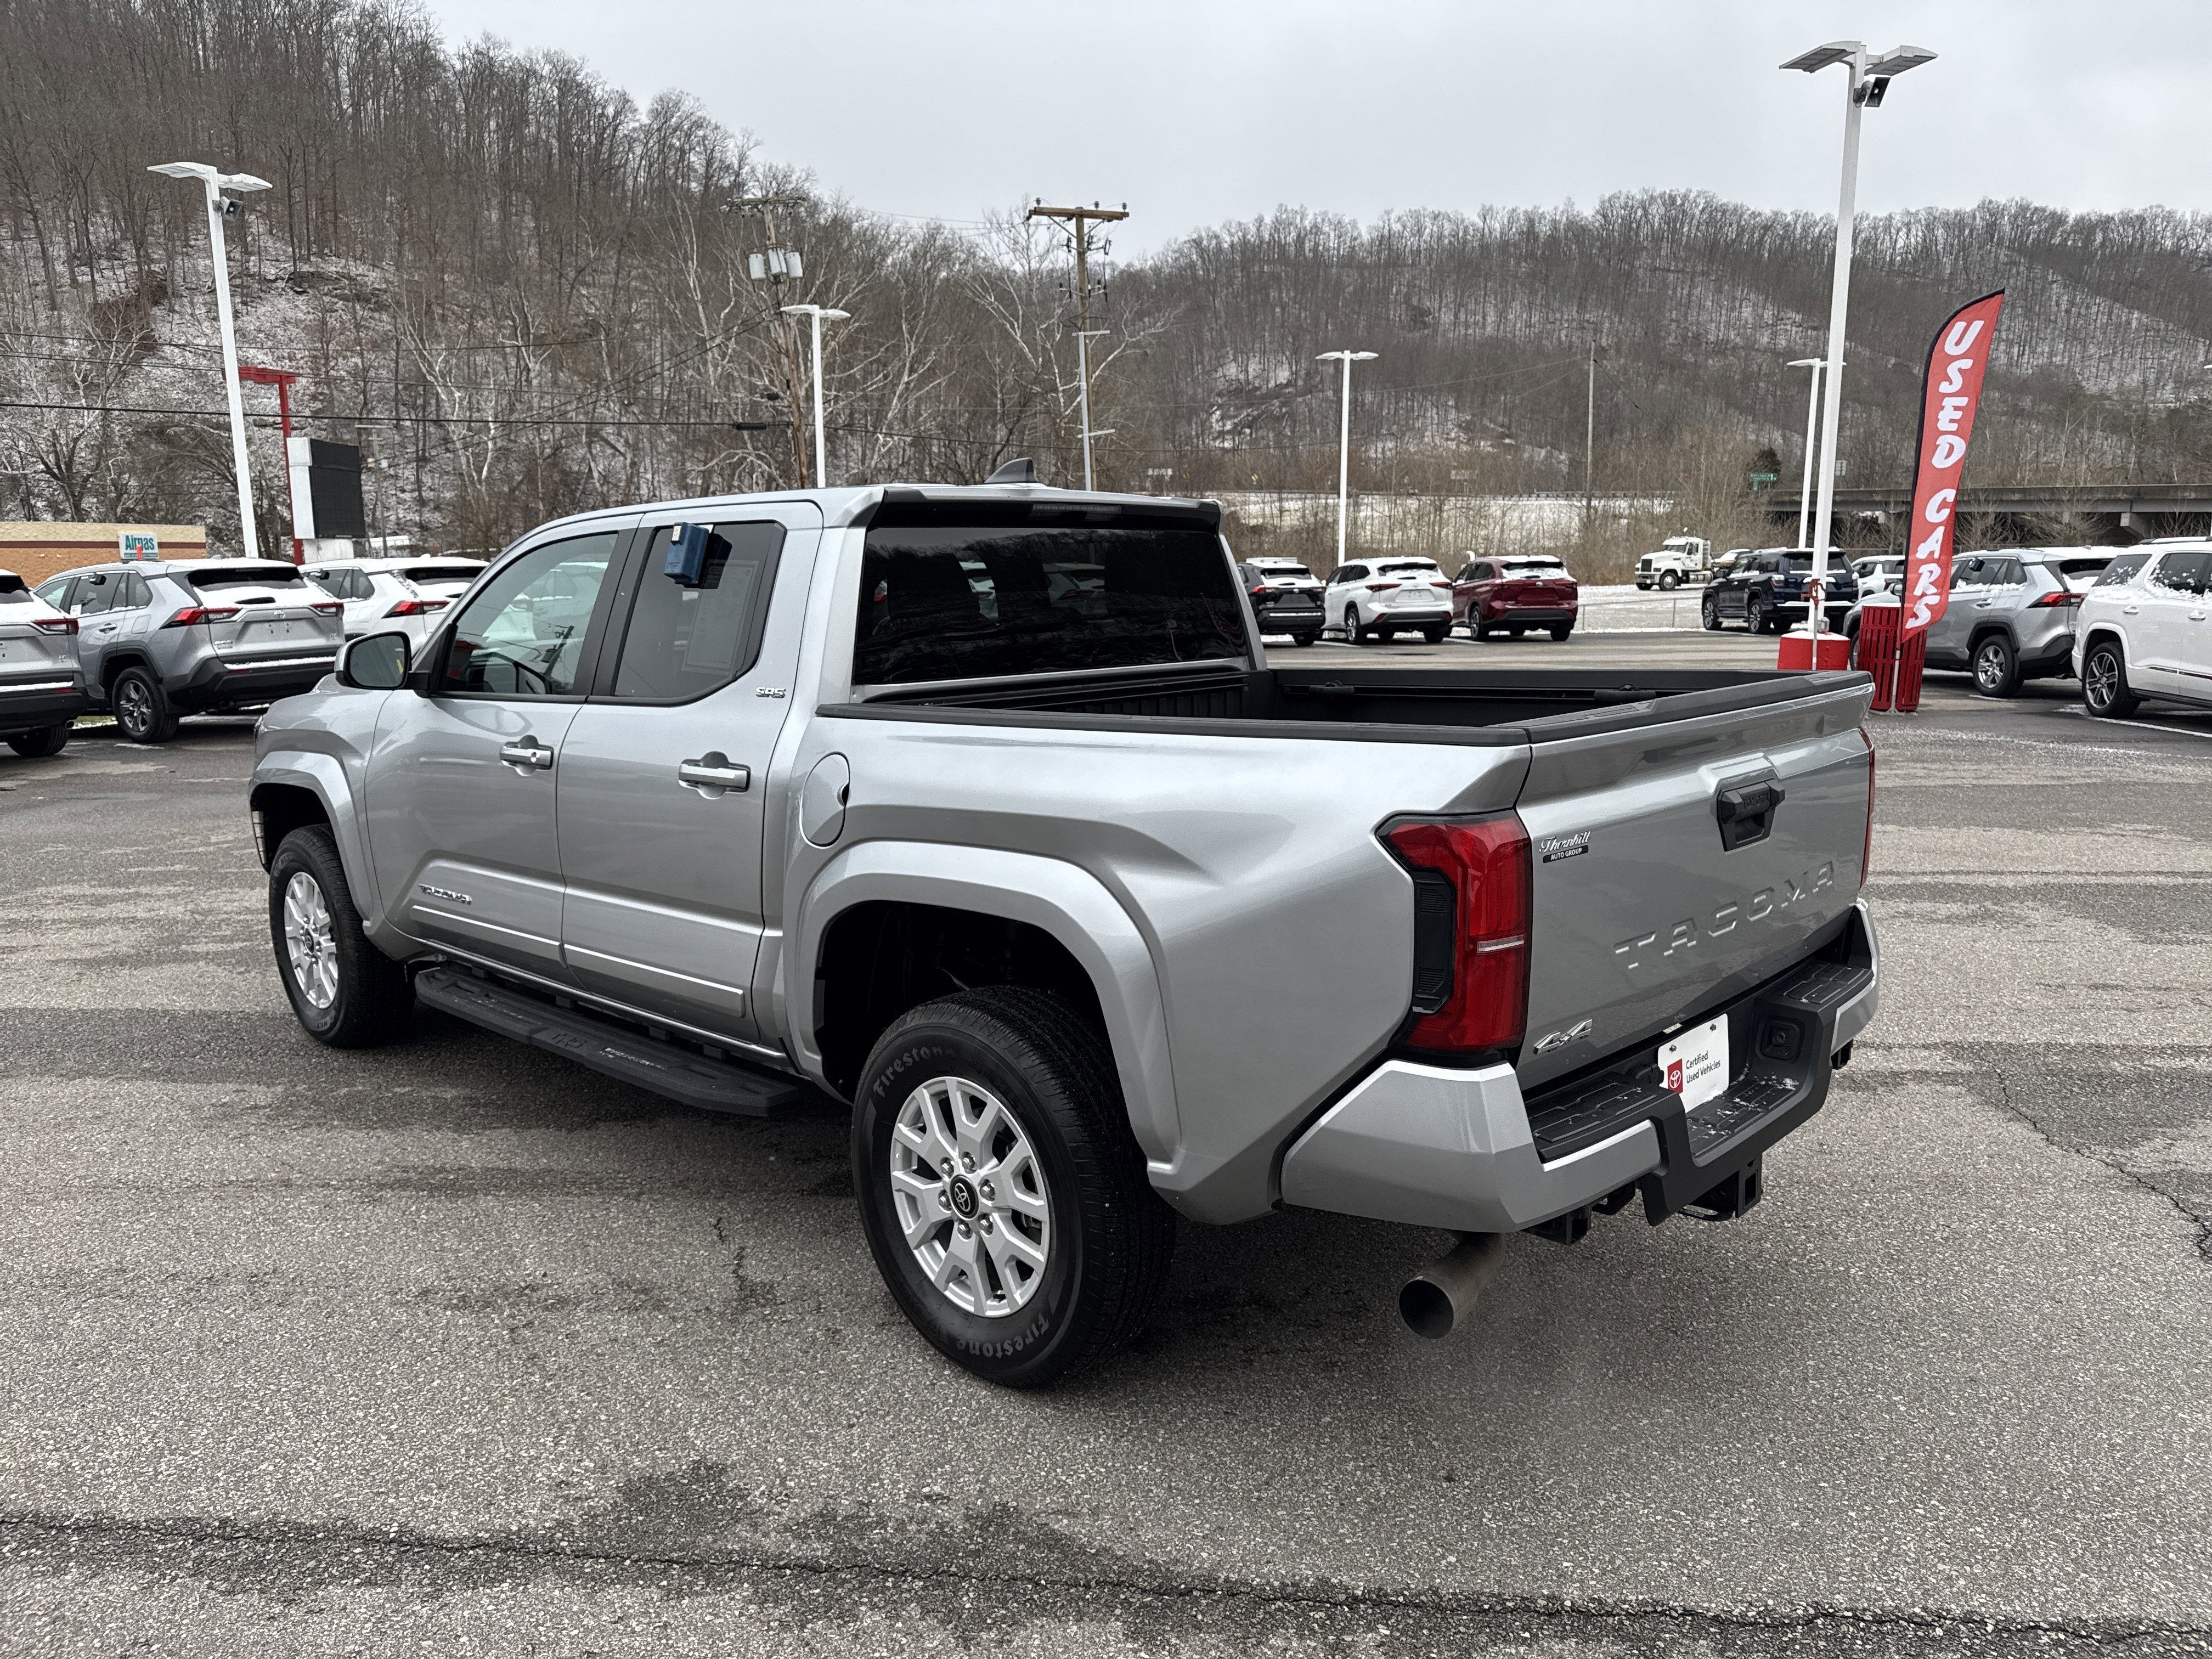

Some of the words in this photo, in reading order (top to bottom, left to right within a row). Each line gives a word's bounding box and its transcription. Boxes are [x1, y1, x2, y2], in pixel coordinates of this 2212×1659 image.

[1931, 320, 1985, 469] USED
[1905, 488, 1956, 630] CARS
[755, 687, 786, 698] SR5
[1538, 831, 1591, 853] Thornhill
[1550, 853, 1565, 861] AUTO
[1565, 848, 1582, 857] GROUP
[1613, 860, 1835, 969] TACOMA
[873, 1046, 956, 1098] Firestone
[1686, 1050, 1708, 1069] Certified
[1686, 1069, 1700, 1084] Used
[1700, 1060, 1720, 1076] Vehicles
[956, 1311, 1049, 1359] Firestone
